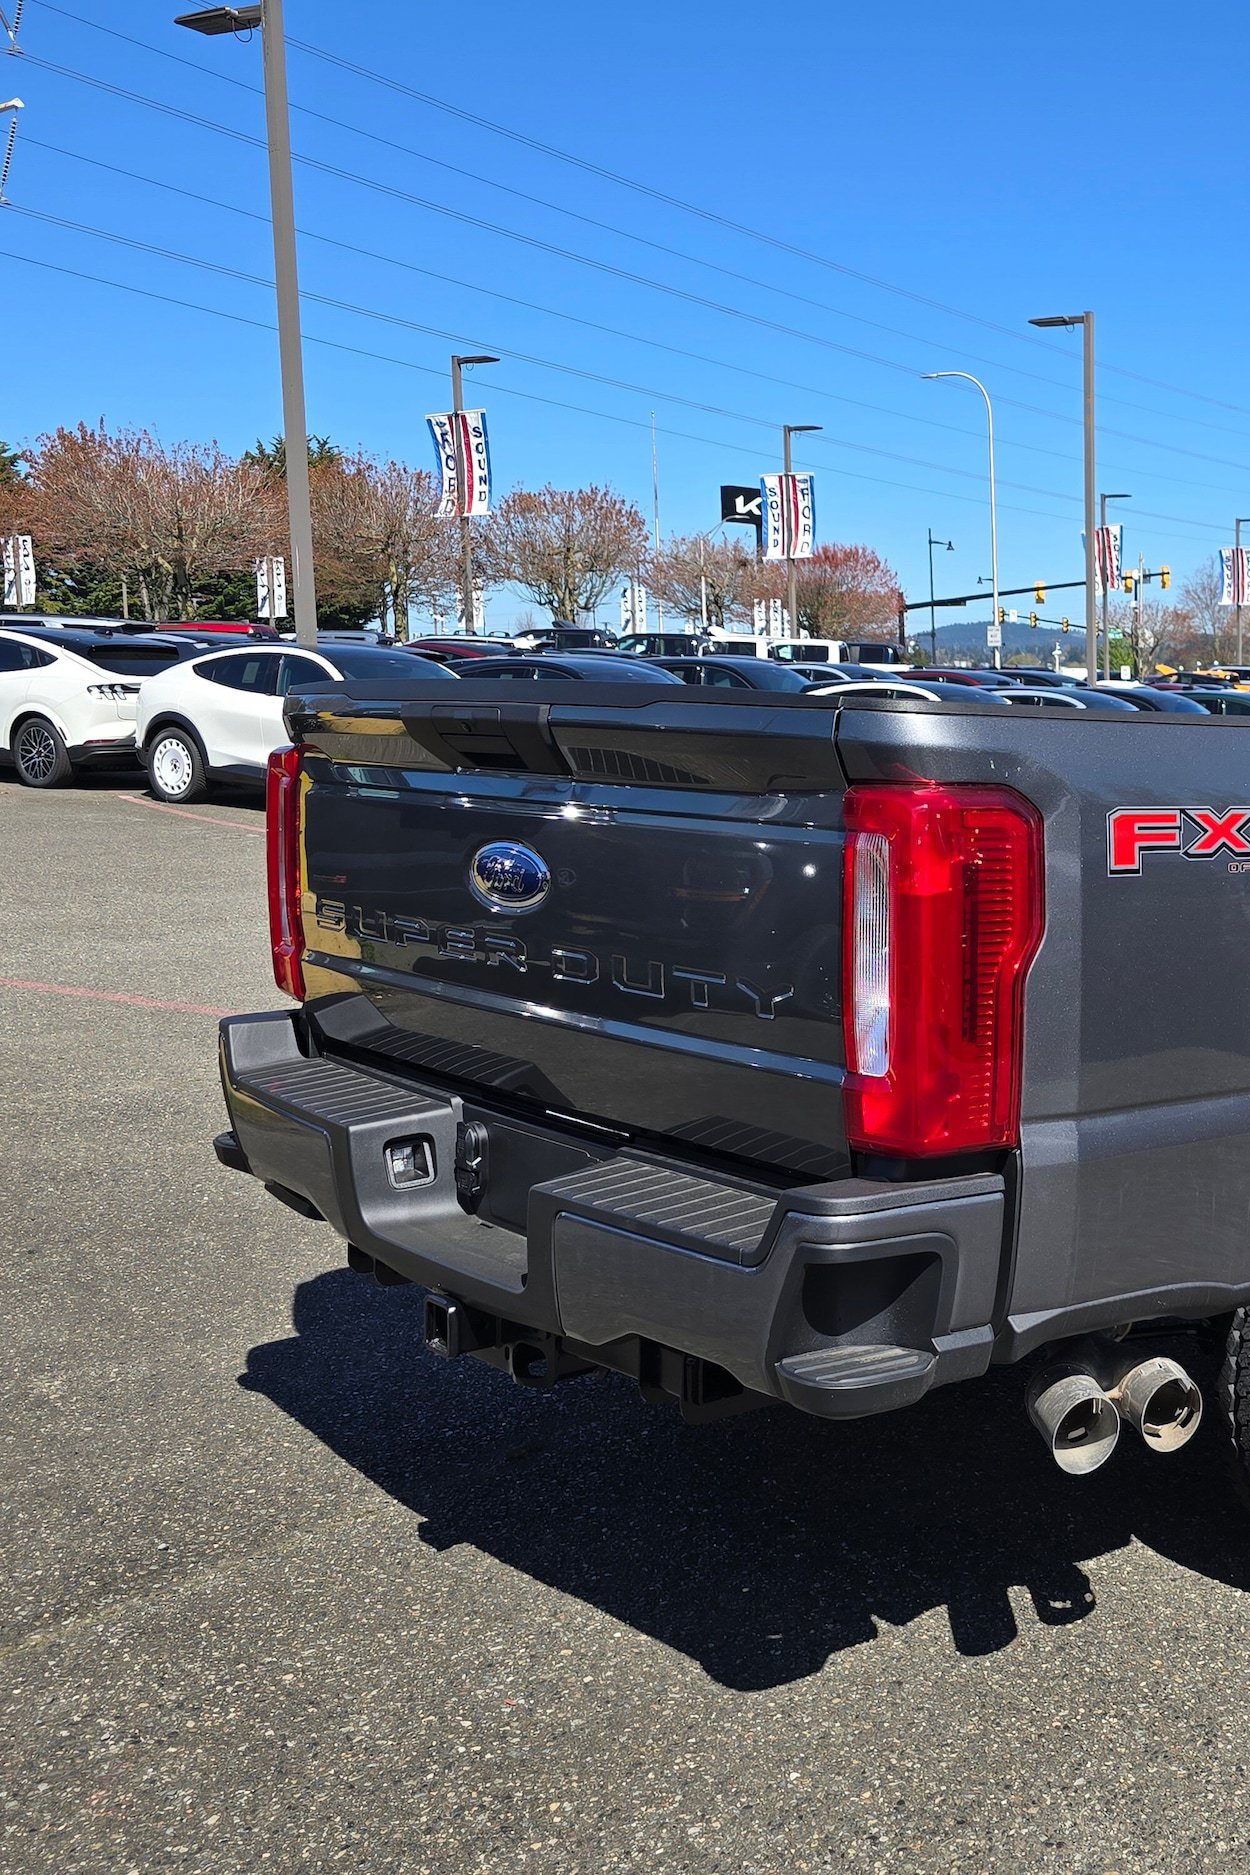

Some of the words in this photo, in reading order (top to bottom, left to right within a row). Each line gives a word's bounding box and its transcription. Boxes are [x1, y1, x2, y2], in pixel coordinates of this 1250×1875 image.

[472, 426, 487, 502] SOUND
[769, 487, 780, 548] SOUND
[801, 487, 811, 553] FORD
[315, 898, 527, 972] SUPER
[551, 943, 795, 1020] DUTY
